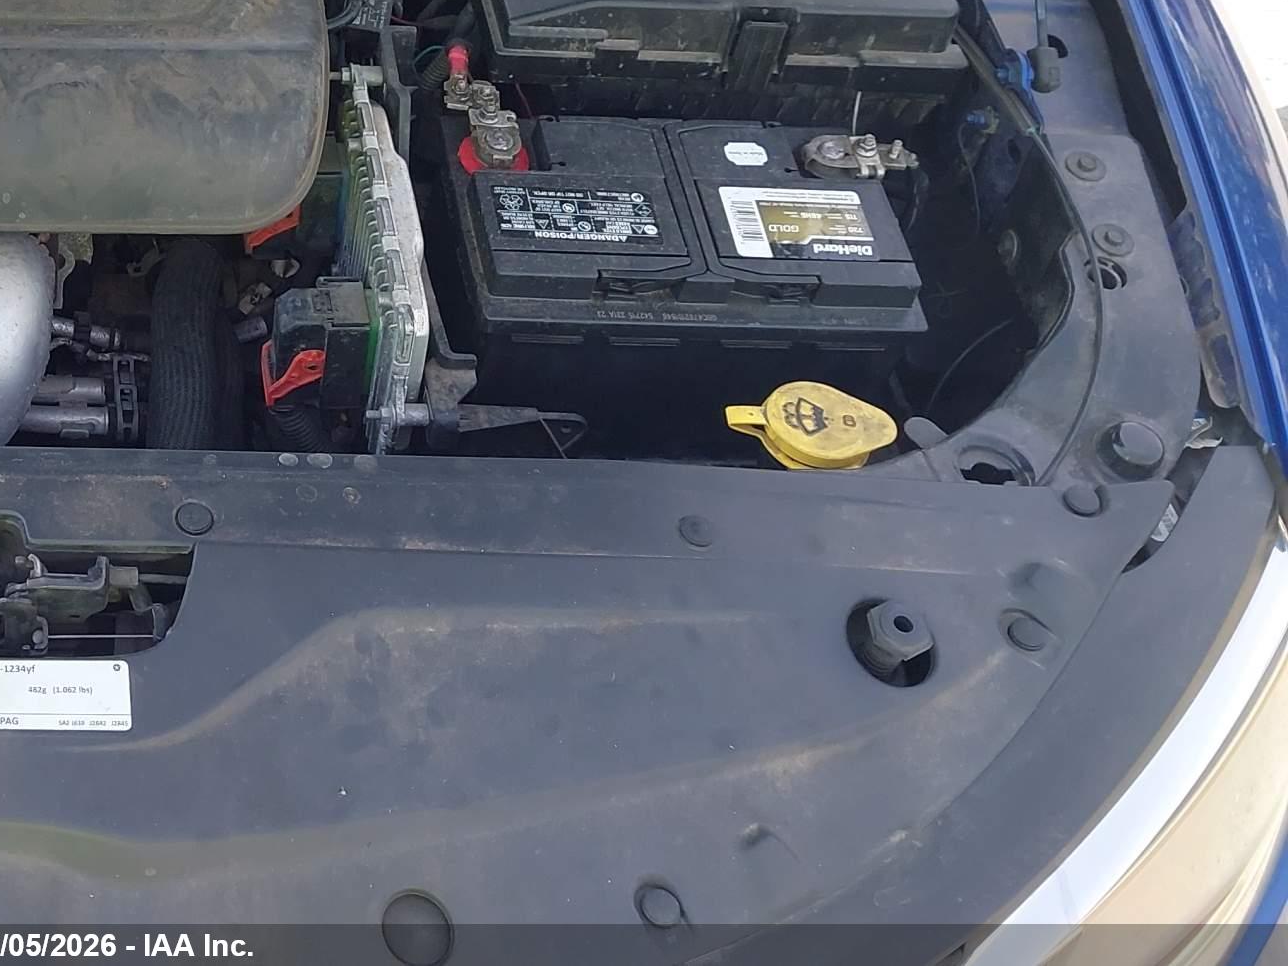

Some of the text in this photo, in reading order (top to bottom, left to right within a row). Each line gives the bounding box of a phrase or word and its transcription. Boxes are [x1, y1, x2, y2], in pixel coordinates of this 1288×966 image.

[769, 224, 799, 233] GOLD
[535, 231, 620, 242] DANGER/POISON
[813, 243, 873, 256] DieHard
[52, 686, 77, 695] (1.062
[0, 717, 19, 725] PAG
